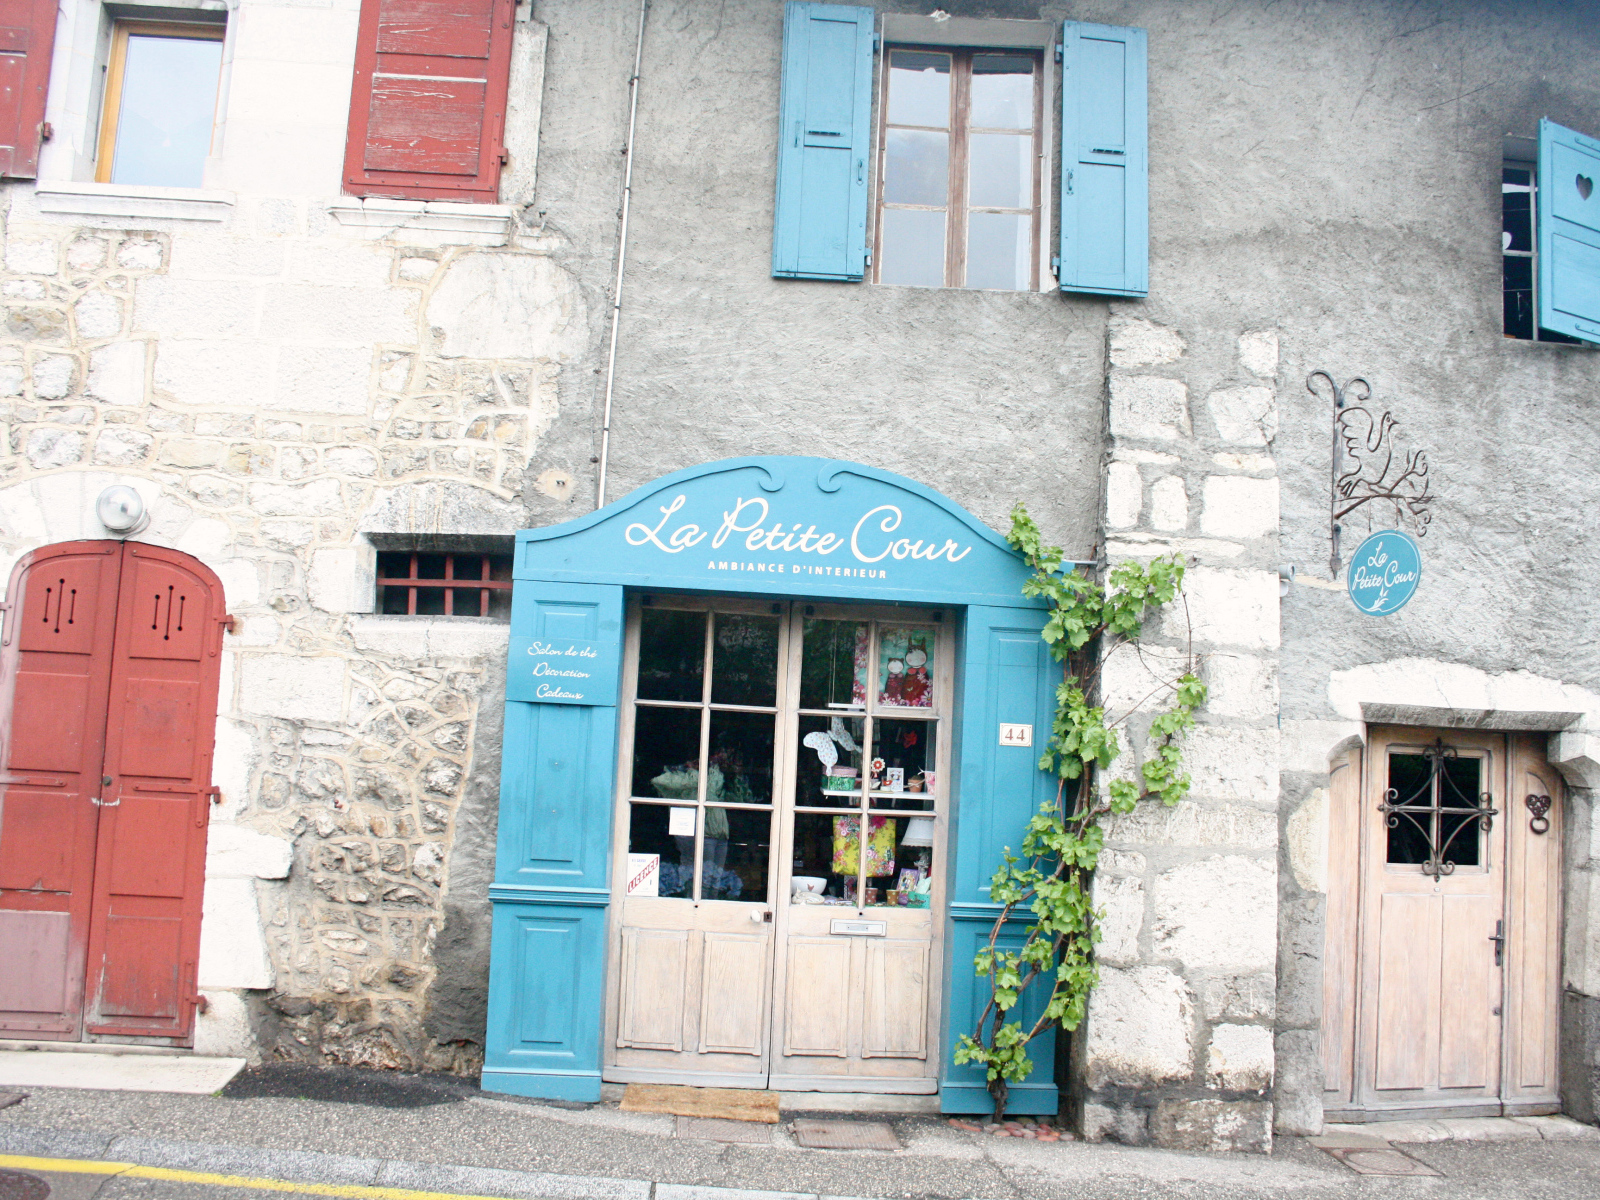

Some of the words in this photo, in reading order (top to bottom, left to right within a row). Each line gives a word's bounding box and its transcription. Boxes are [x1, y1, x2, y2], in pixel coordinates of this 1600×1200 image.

[625, 494, 708, 554] La
[711, 497, 845, 555] Petite
[851, 504, 972, 563] Cour
[1367, 541, 1388, 567] La
[707, 560, 785, 573] AMBIANCE
[792, 564, 887, 579] D'INTERIEUR
[1352, 566, 1383, 590] Petite
[1384, 560, 1416, 587] Cour
[527, 641, 562, 656] Salon
[564, 645, 579, 657] de
[579, 646, 598, 658] thé
[532, 661, 591, 678] Décoration
[536, 683, 584, 700] Cadeaux
[1005, 728, 1025, 741] 44
[629, 857, 658, 891] LICENCE
